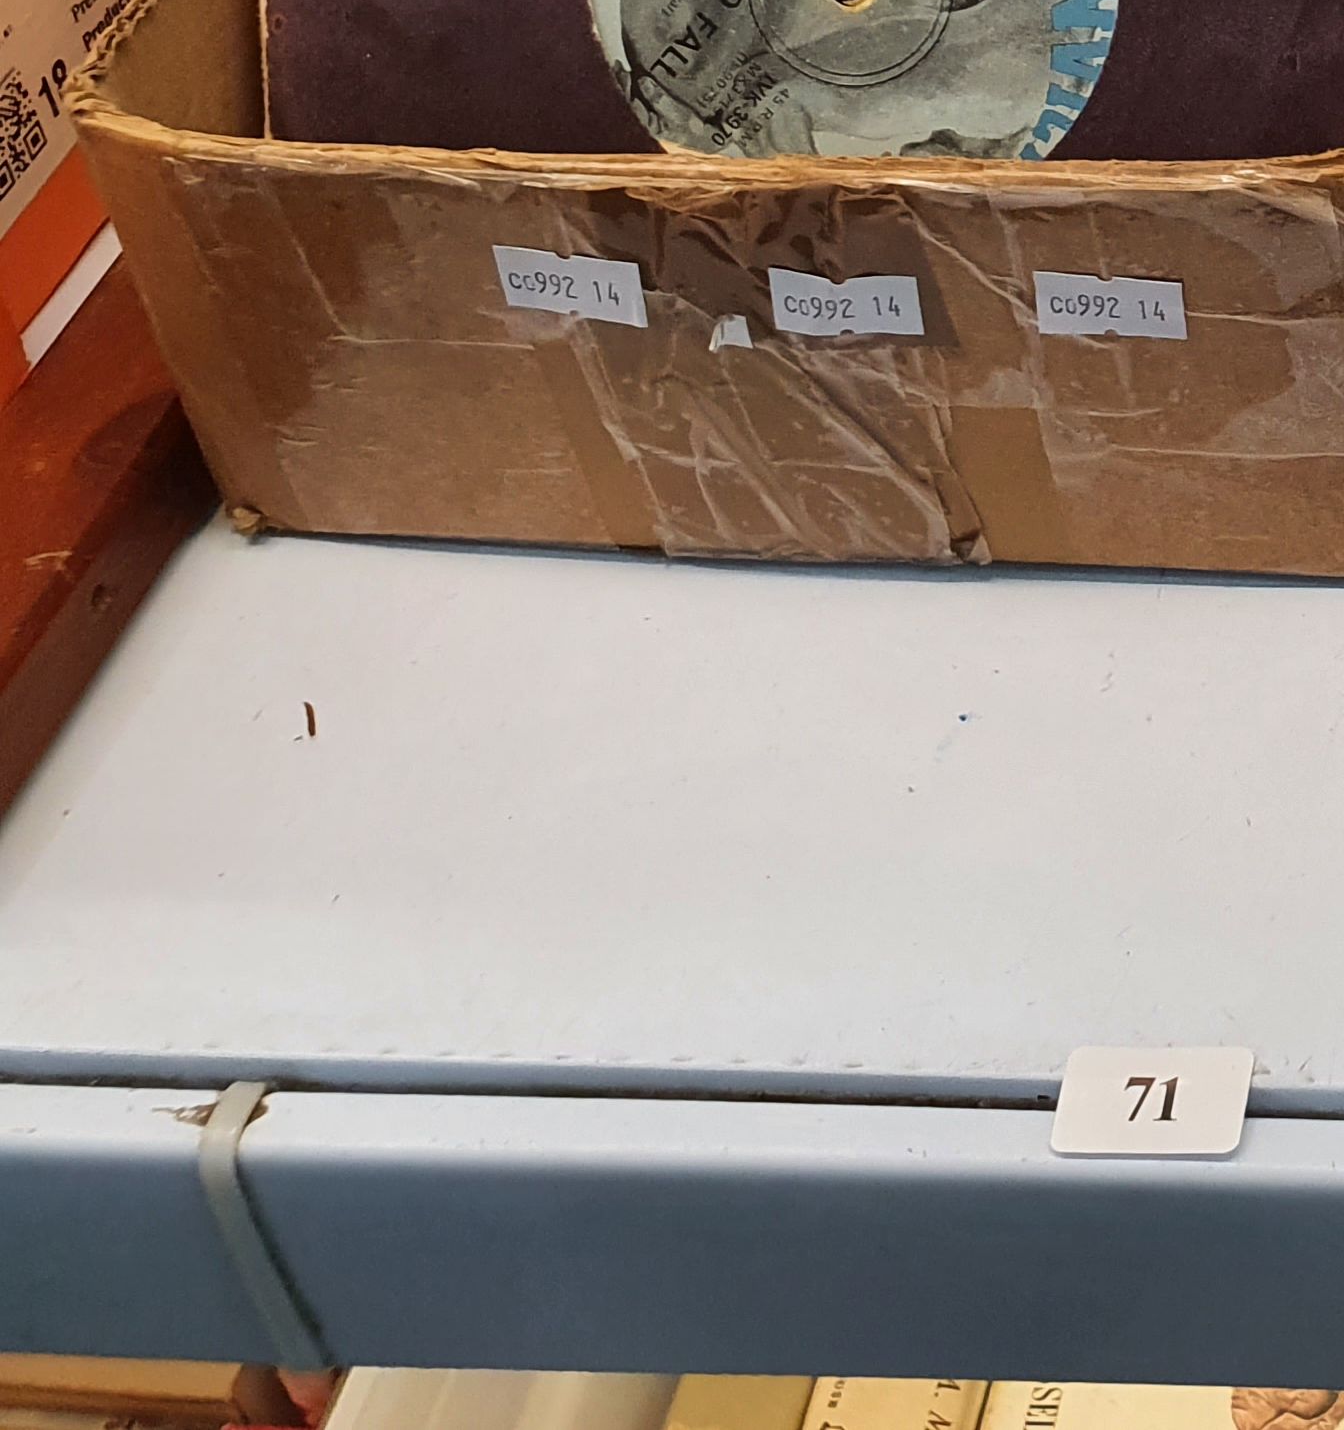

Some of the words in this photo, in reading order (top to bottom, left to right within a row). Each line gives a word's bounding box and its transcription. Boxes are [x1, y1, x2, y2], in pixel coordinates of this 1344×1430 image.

[649, 10, 720, 87] FALL
[709, 72, 778, 149] IVK-3970
[593, 280, 620, 306] 14
[873, 295, 901, 317] 14
[1138, 300, 1166, 321] 14
[1124, 1076, 1179, 1122] 71
